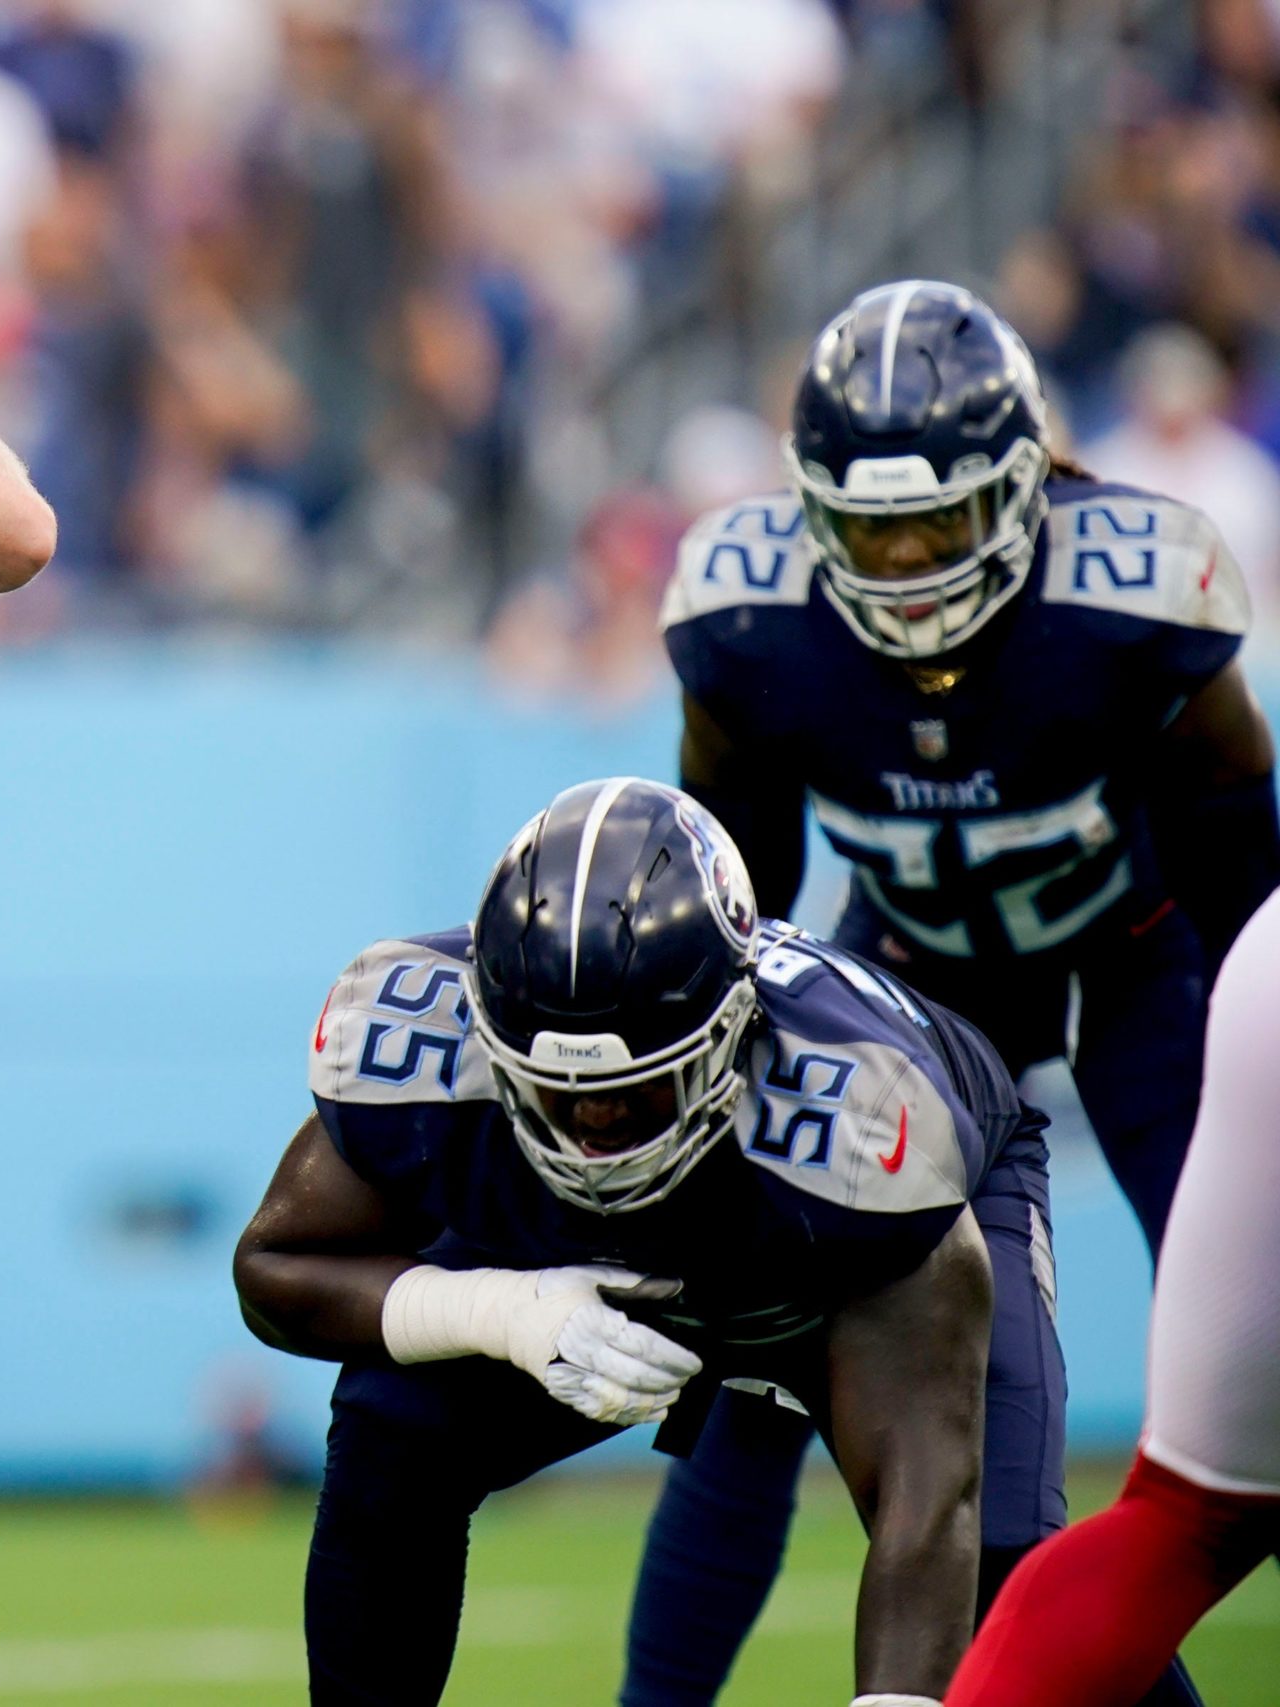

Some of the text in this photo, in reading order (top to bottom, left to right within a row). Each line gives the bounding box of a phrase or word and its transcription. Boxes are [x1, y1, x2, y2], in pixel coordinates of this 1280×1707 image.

[703, 506, 807, 593] 22
[1074, 505, 1157, 592] 22
[356, 961, 473, 1100] 55
[745, 1030, 860, 1171] 55
